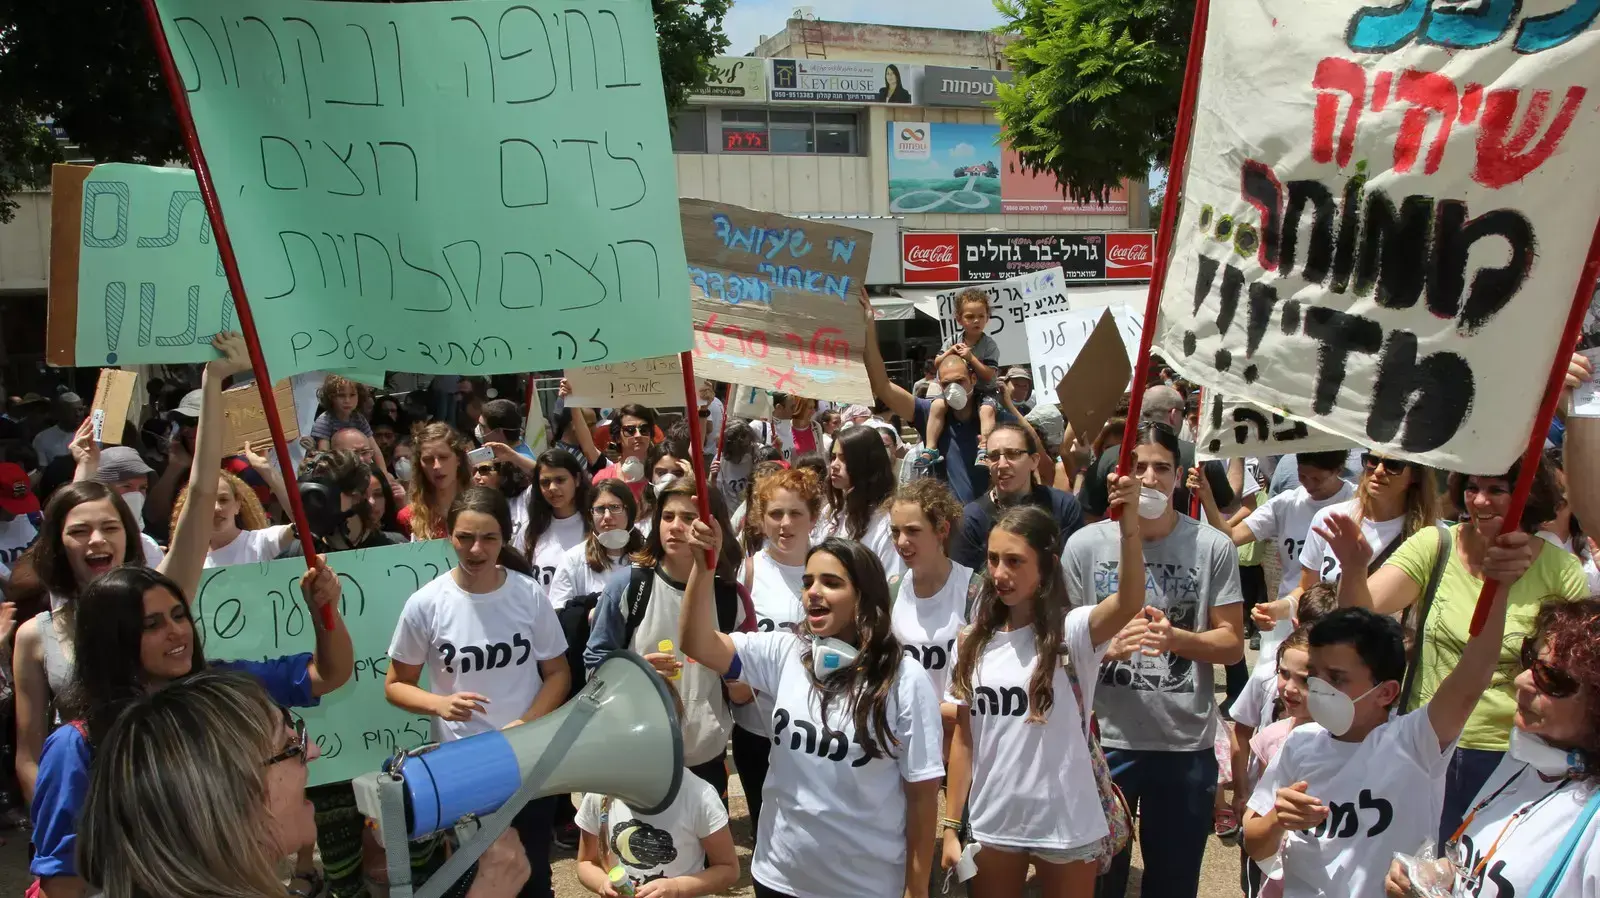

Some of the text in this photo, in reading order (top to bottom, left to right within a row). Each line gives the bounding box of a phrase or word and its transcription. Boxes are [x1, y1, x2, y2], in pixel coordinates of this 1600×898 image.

[173, 5, 641, 119] בחיפה ובקריות
[941, 79, 994, 95] טפחות
[500, 131, 647, 211] ילדים
[907, 244, 953, 262] Coca-Cola
[966, 238, 1099, 262] גריל-בר גחלים
[1108, 244, 1147, 261] Coca-Cola
[968, 269, 991, 280] שניצל
[1066, 269, 1098, 278] שווארמה
[290, 324, 388, 368] שלכם
[418, 335, 513, 367] העתיד
[552, 327, 608, 363] זה
[1093, 570, 1200, 600] REATTA
[438, 632, 531, 674] למה?
